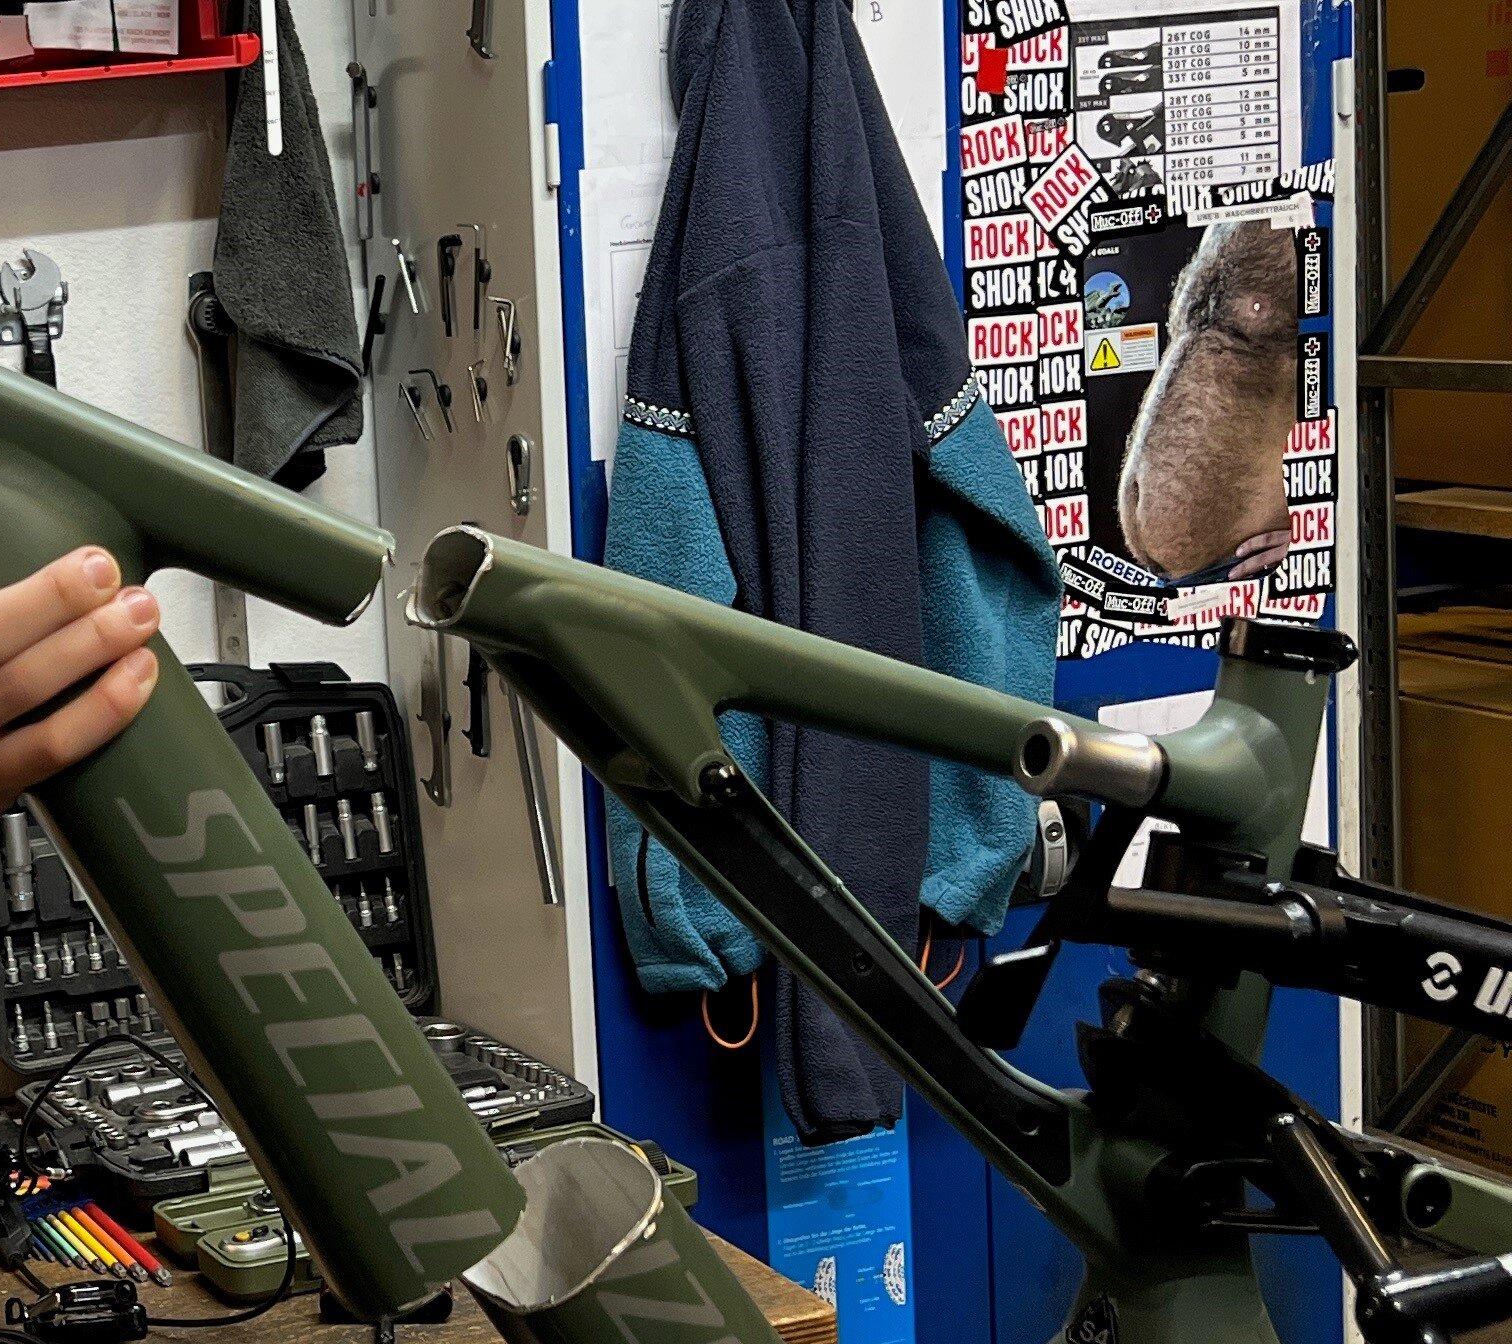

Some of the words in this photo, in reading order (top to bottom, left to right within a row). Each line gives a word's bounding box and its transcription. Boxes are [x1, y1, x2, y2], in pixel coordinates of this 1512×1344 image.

[1189, 29, 1211, 41] COG
[1239, 26, 1250, 36] 14
[1254, 26, 1271, 36] mm
[1189, 43, 1211, 54] COG
[1239, 40, 1250, 50] 10
[1254, 40, 1271, 49] mm
[1190, 57, 1211, 68] COG
[1239, 54, 1250, 64] 10
[1254, 54, 1271, 62] mm
[1190, 70, 1212, 82] COG
[1241, 67, 1249, 77] 5
[1254, 67, 1271, 76] mm
[1191, 93, 1212, 104] COG
[1239, 89, 1250, 100] 12
[1254, 89, 1271, 98] mm
[1191, 107, 1213, 117] COG
[1239, 103, 1251, 113] 10
[1254, 103, 1271, 112] mm
[1191, 120, 1213, 131] COG
[1240, 117, 1246, 127] 5
[1254, 116, 1271, 125] mm
[961, 121, 1022, 170] ROCK
[1192, 133, 1214, 145] COG
[1240, 130, 1247, 140] 5
[1254, 129, 1272, 139] mm
[1193, 155, 1214, 167] COG
[1240, 152, 1250, 162] 11
[1255, 152, 1272, 161] mm
[1193, 169, 1214, 180] COG
[1240, 166, 1247, 176] 7
[1255, 165, 1272, 174] mm
[964, 166, 1027, 217] SHOX
[1030, 152, 1094, 223] ROCK
[1093, 211, 1142, 230] Muc-Off
[970, 219, 1030, 261] ROCK
[971, 265, 1033, 310] SHOX
[1306, 254, 1320, 313] Muc-Off
[974, 320, 1033, 360] ROCK
[1306, 359, 1320, 418] Muc-Off
[1090, 549, 1156, 588] ROBERT
[1274, 550, 1331, 593] SHOX
[1062, 565, 1105, 597] Muc-Off
[1106, 594, 1154, 613] Muc-Off
